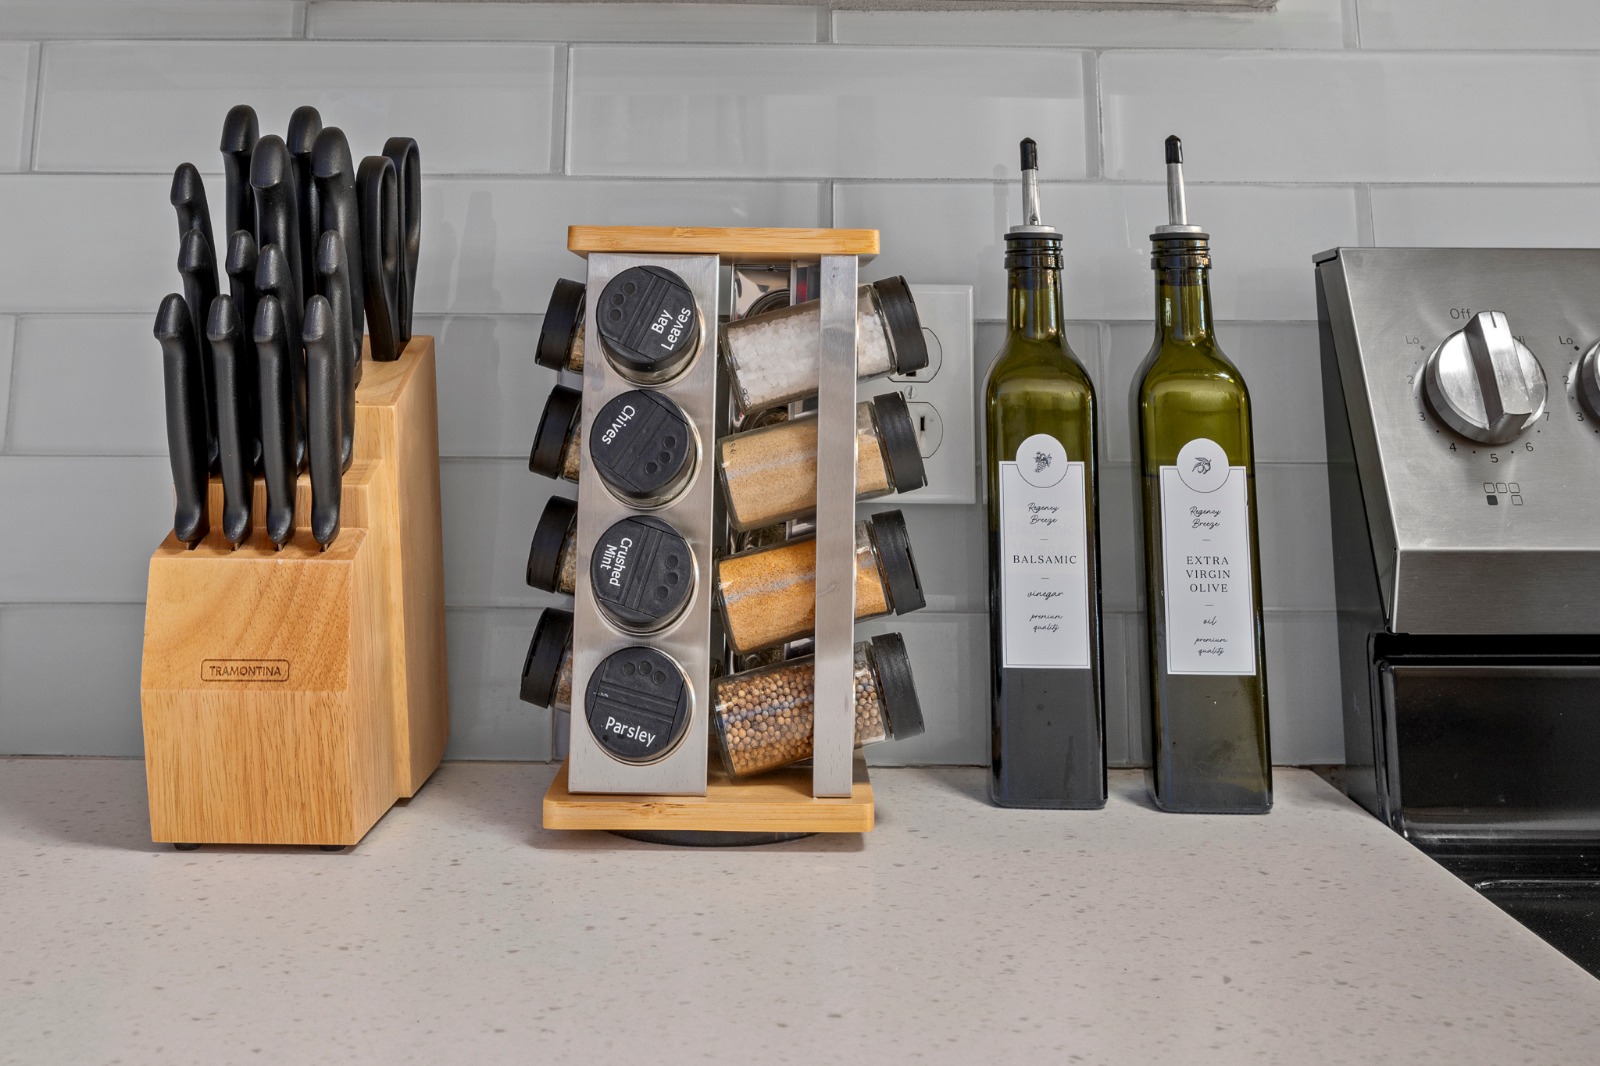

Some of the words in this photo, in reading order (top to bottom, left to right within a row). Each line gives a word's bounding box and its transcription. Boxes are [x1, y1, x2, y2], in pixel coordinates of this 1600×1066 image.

[1449, 308, 1471, 320] Off
[651, 309, 674, 334] Bay
[661, 307, 691, 351] Leaves
[1405, 336, 1420, 345] Lo
[1559, 335, 1573, 345] Lo
[1406, 375, 1415, 385] 2
[1562, 375, 1570, 385] 2
[1418, 412, 1426, 422] 3
[1543, 412, 1551, 421] 7
[1576, 412, 1584, 422] 3
[601, 405, 636, 445] Chives
[1449, 442, 1457, 452] 4
[1525, 442, 1534, 452] 6
[1490, 454, 1499, 463] 5
[1027, 502, 1059, 514] Regency
[1189, 506, 1221, 517] Regency
[1030, 515, 1057, 526] Breeze
[1192, 518, 1220, 530] Breeze
[600, 544, 618, 570] Mint
[609, 537, 633, 587] Crushed
[1013, 555, 1077, 564] BALSAMIC
[1186, 556, 1229, 565] EXTRA
[1186, 570, 1231, 579] VIRGIN
[1189, 584, 1228, 592] OLIVE
[1027, 591, 1063, 600] vinegar
[1029, 614, 1063, 622] premium
[1203, 616, 1217, 625] oil
[1033, 623, 1059, 632] quality
[1194, 637, 1228, 645] premium
[1198, 647, 1224, 656] quality
[209, 666, 281, 676] TRAMONTINA
[605, 716, 656, 747] Parsley
